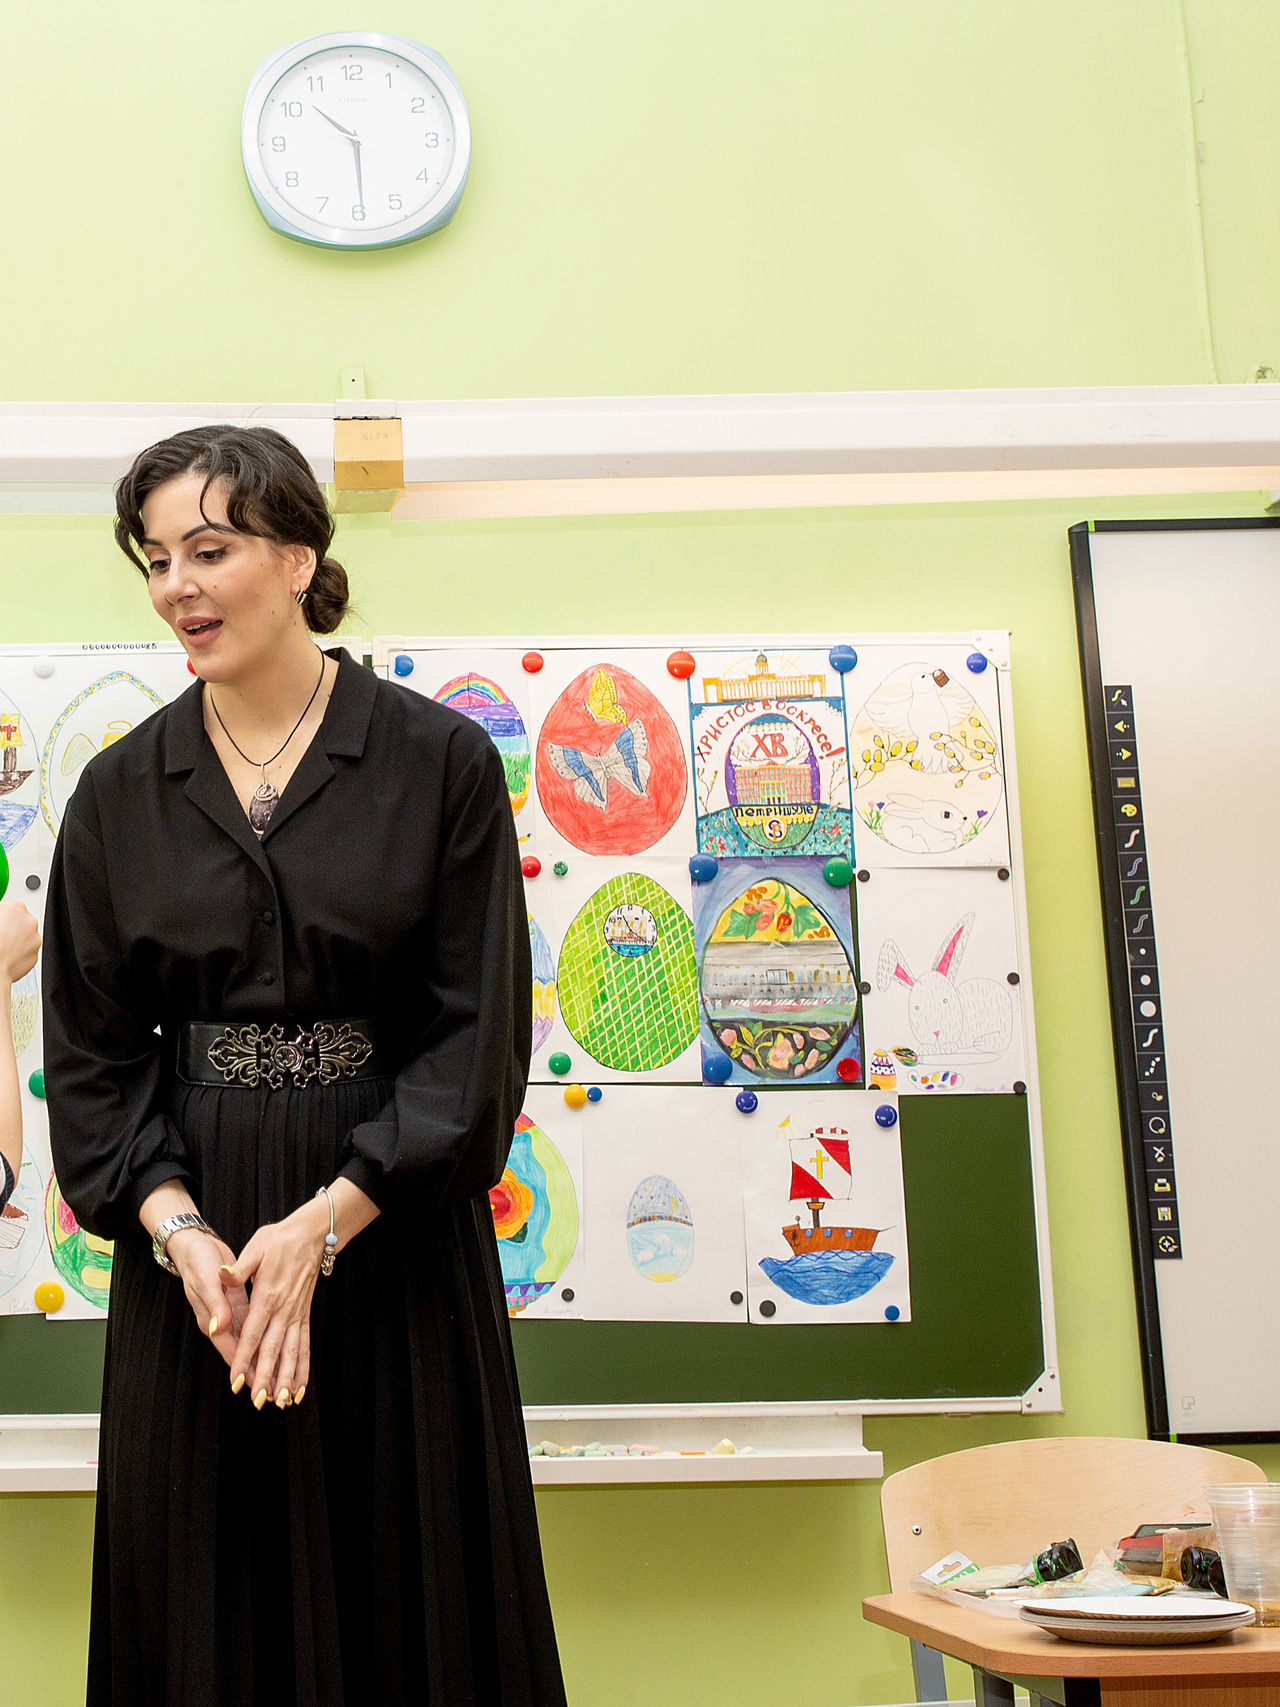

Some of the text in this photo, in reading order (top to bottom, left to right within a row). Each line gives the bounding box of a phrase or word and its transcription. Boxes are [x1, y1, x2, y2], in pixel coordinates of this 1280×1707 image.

[341, 65, 363, 81] 12
[385, 72, 392, 88] 1
[306, 76, 324, 92] 11
[280, 101, 303, 118] 10
[411, 97, 426, 114] 2
[272, 136, 286, 152] 9
[425, 132, 439, 148] 3
[285, 171, 299, 187] 8
[415, 168, 430, 183] 4
[315, 197, 329, 213] 7
[388, 194, 402, 210] 5
[351, 204, 366, 221] 6
[750, 732, 789, 758] ХВ
